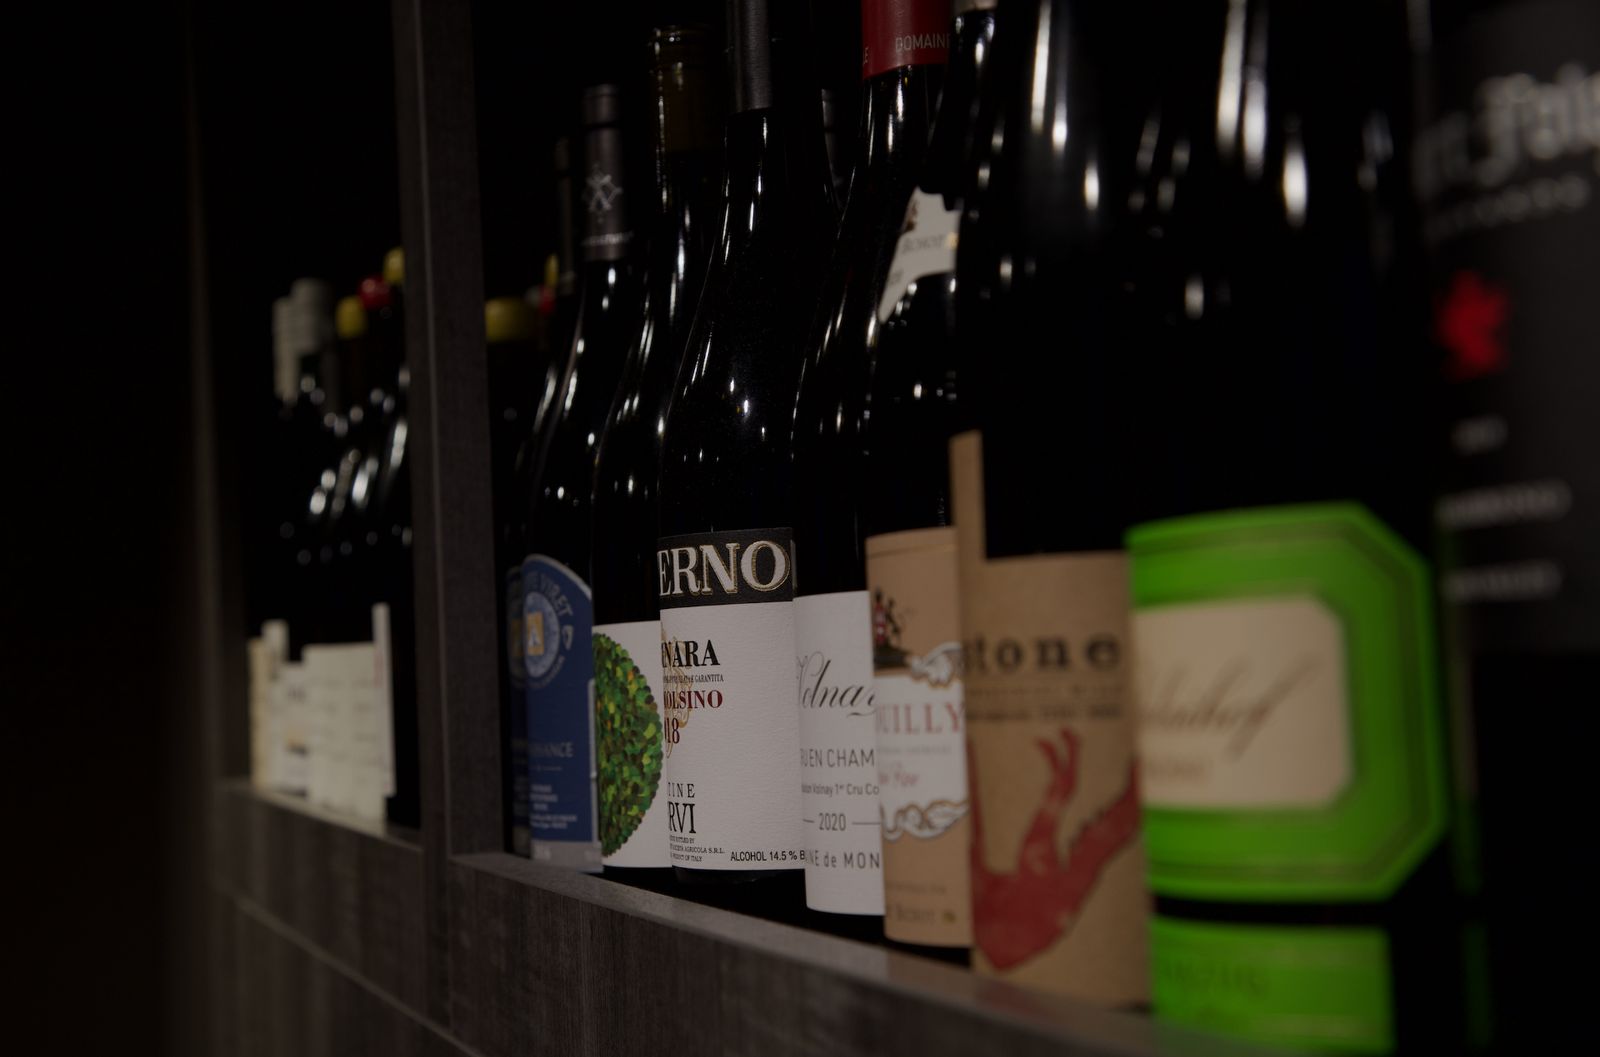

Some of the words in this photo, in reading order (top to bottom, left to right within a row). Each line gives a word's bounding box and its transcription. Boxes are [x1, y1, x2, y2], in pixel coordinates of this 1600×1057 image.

[656, 540, 791, 597] ERNO
[827, 748, 875, 768] CHAM
[847, 784, 863, 796] Cru
[667, 801, 697, 834] RVI
[818, 813, 846, 831] 2020
[730, 851, 767, 862] ALCOHOL
[769, 850, 787, 861] 14.5
[788, 850, 798, 861] %
[824, 851, 837, 868] de
[843, 852, 880, 870] MON
